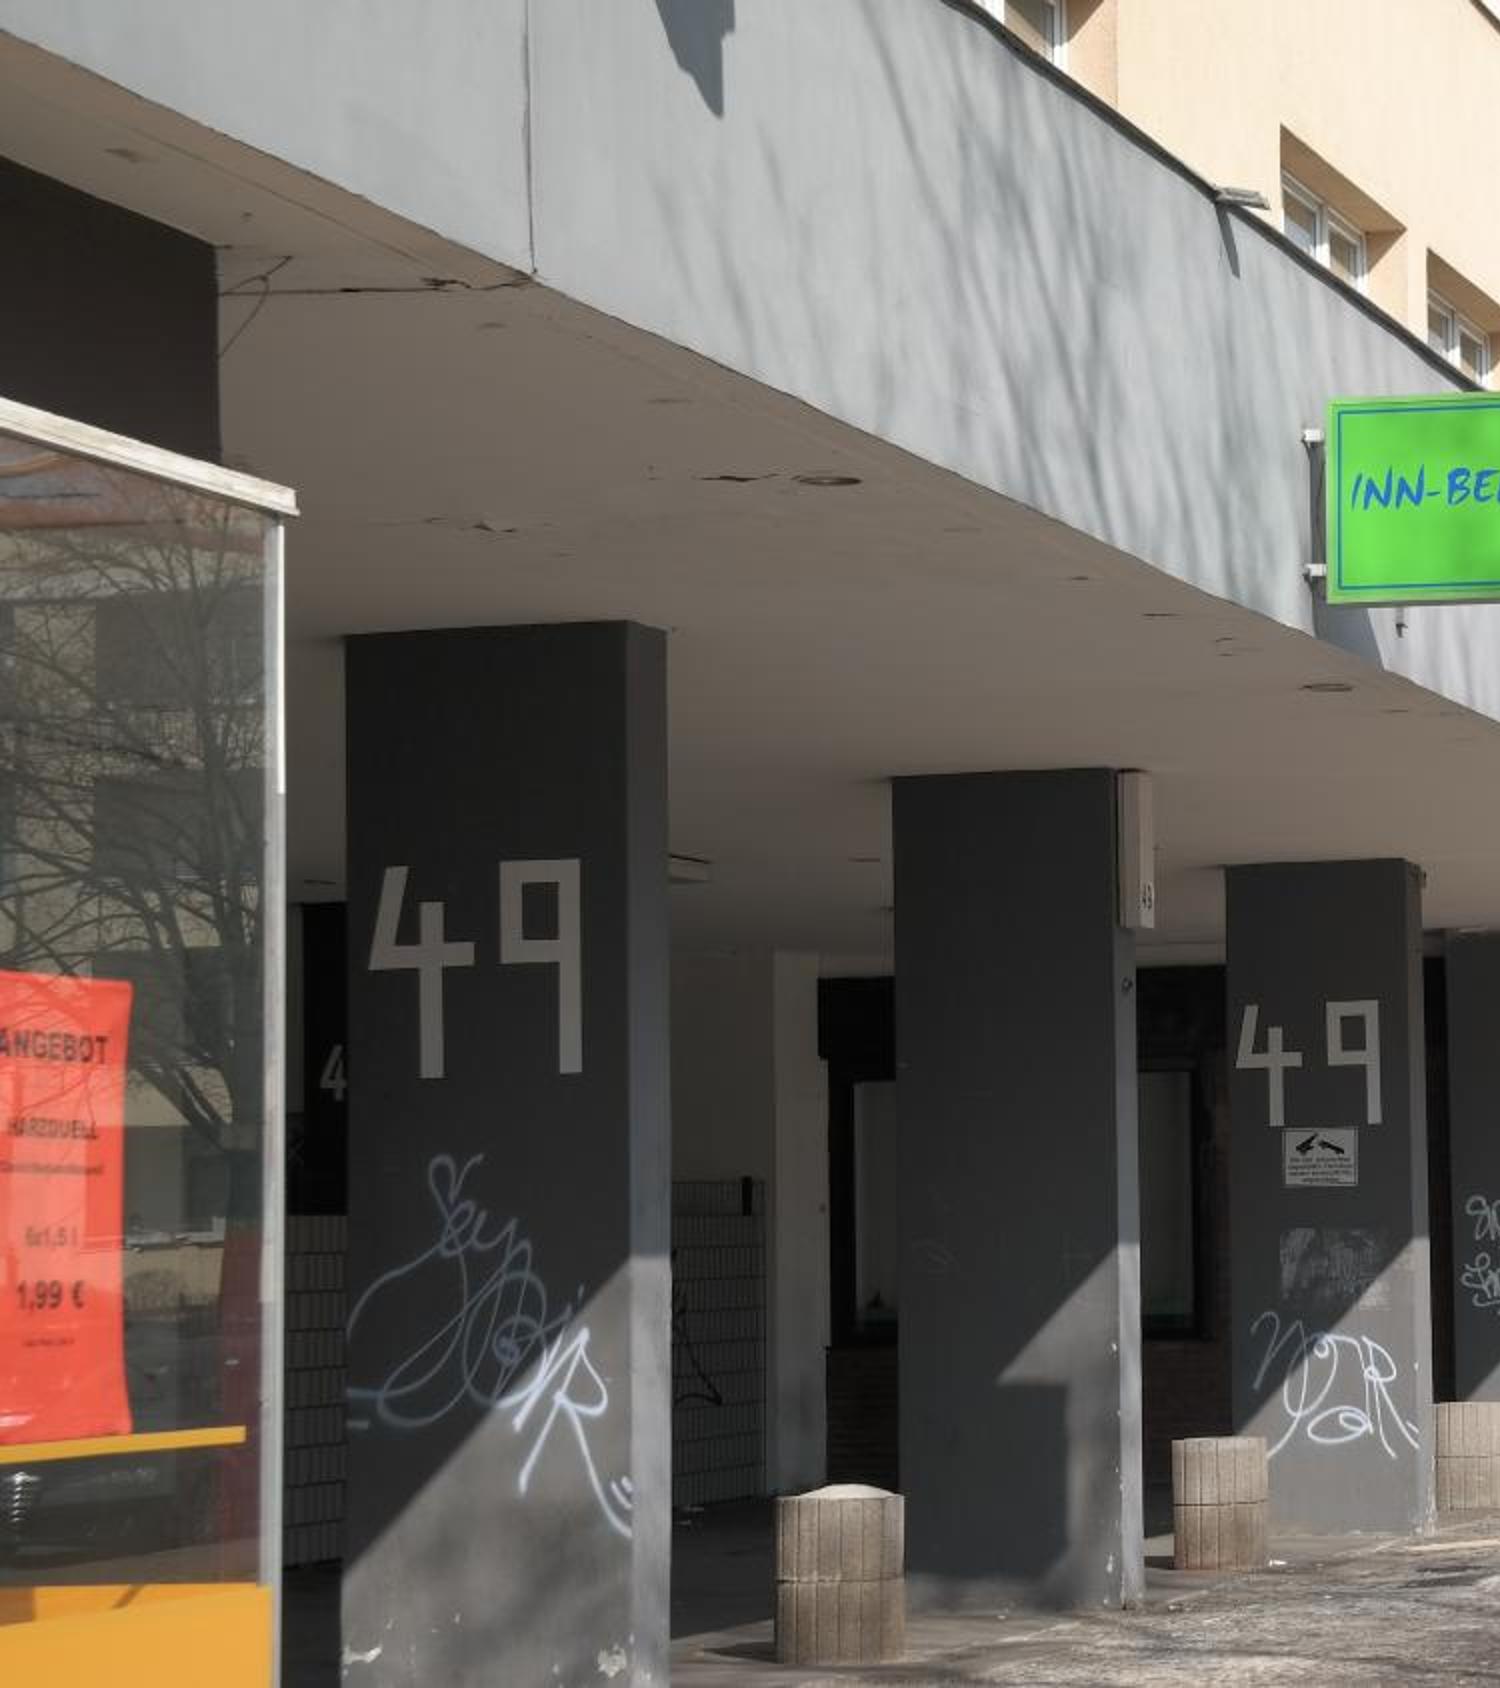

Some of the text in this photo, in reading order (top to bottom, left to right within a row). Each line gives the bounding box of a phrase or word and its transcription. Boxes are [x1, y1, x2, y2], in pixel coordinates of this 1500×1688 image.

[368, 858, 583, 1079] 49
[1236, 1000, 1382, 1127] 49
[17, 1279, 86, 1315] 1,99 €
